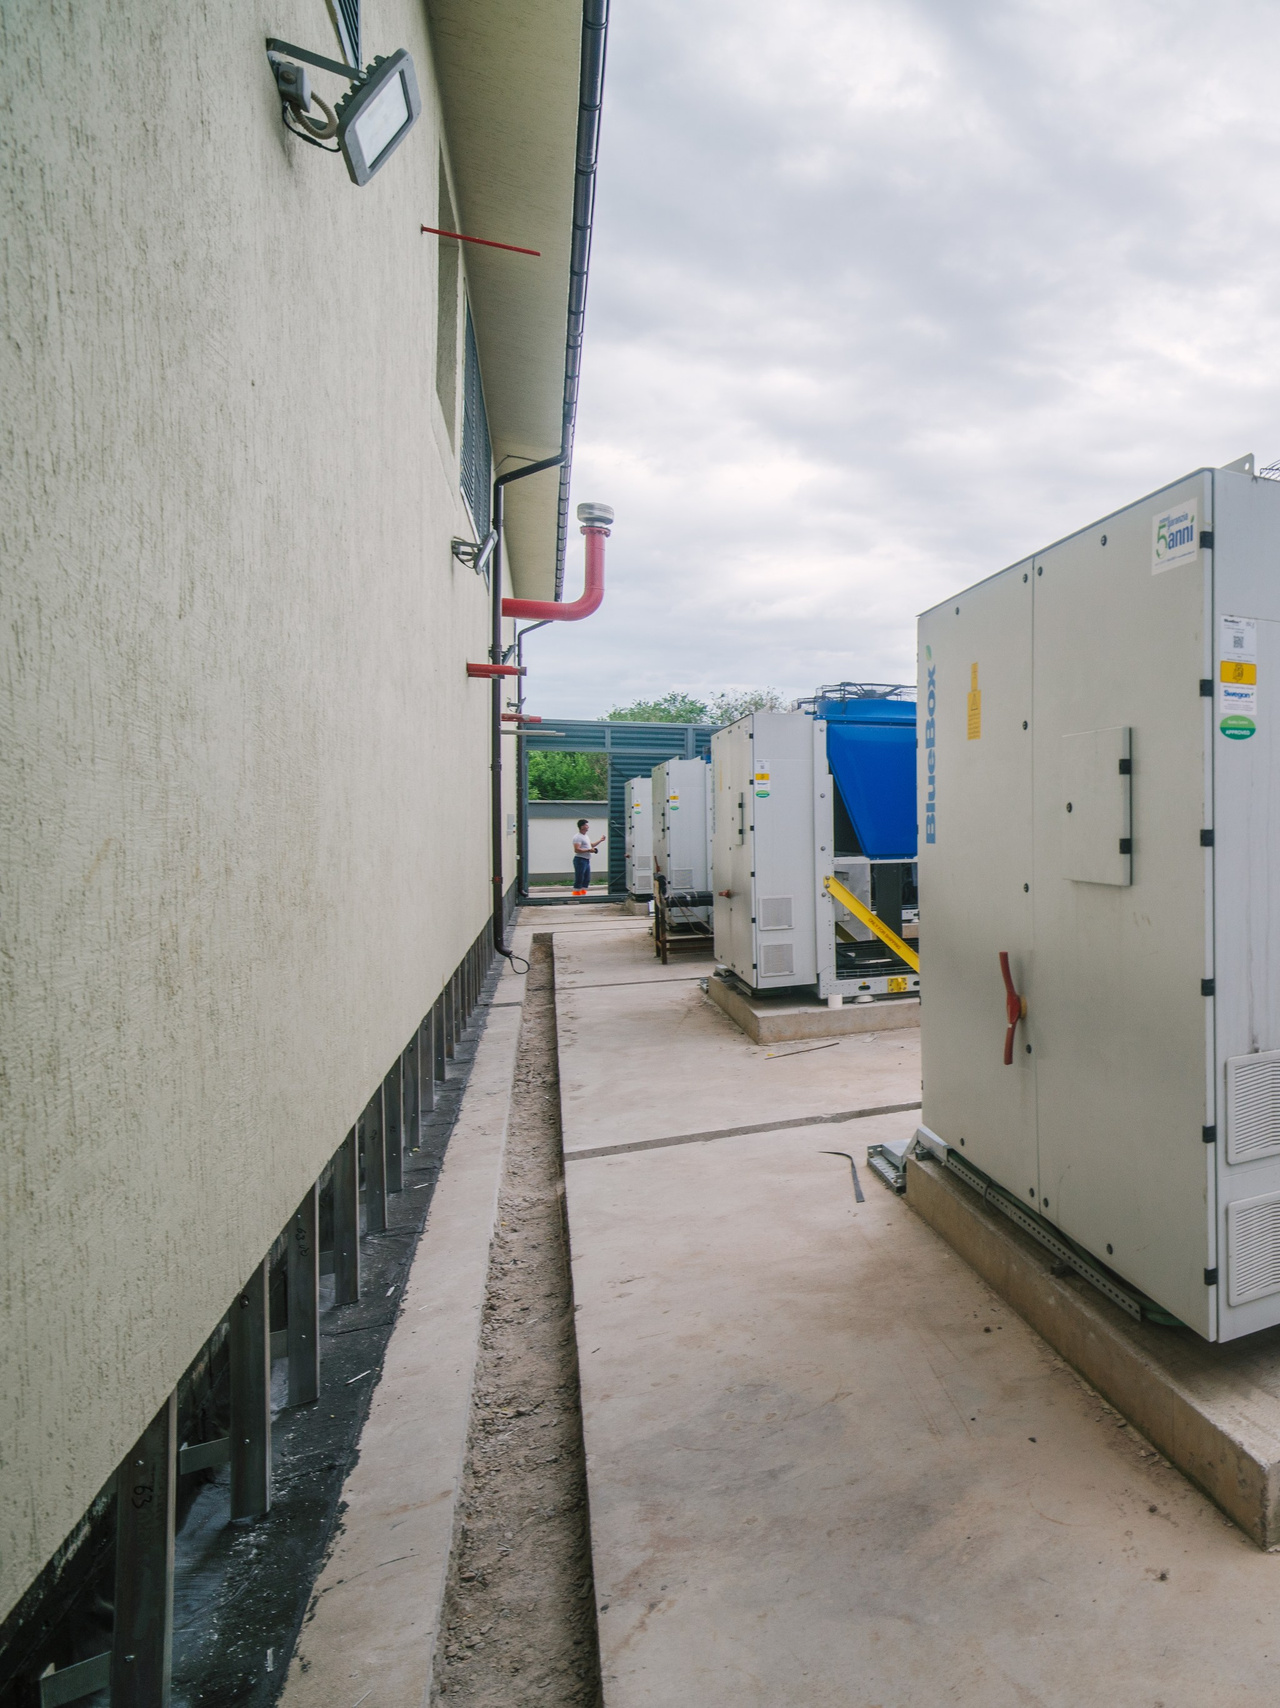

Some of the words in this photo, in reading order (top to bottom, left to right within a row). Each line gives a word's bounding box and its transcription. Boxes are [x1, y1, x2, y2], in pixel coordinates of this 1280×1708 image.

[1156, 523, 1168, 560] 5
[1168, 514, 1194, 550] anni
[1224, 689, 1250, 699] Swegon
[925, 664, 936, 844] BlueBox
[131, 1485, 154, 1509] 63
